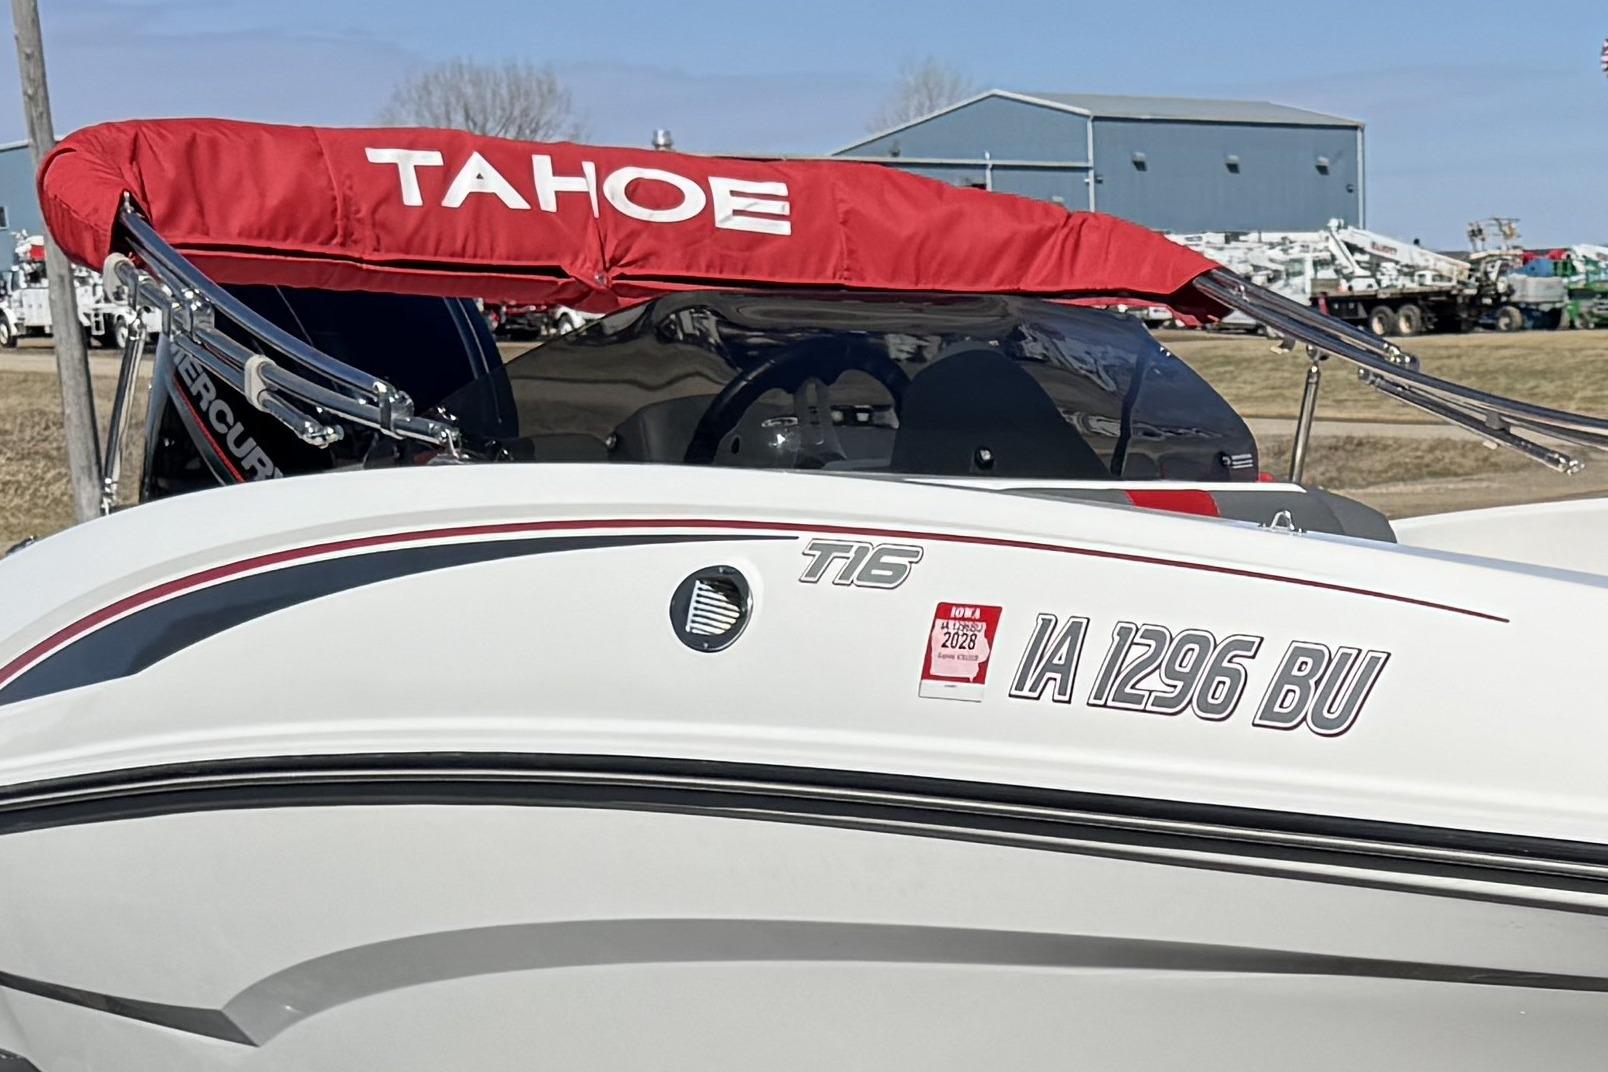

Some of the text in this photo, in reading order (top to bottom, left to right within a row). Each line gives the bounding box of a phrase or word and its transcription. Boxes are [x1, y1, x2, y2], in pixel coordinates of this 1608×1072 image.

[365, 147, 791, 236] TAHOE
[172, 350, 283, 480] ERCUR
[799, 537, 924, 589] T16
[941, 631, 978, 650] 2028
[950, 606, 981, 619] IOWA
[1008, 613, 1391, 738] IA 1296 BU
